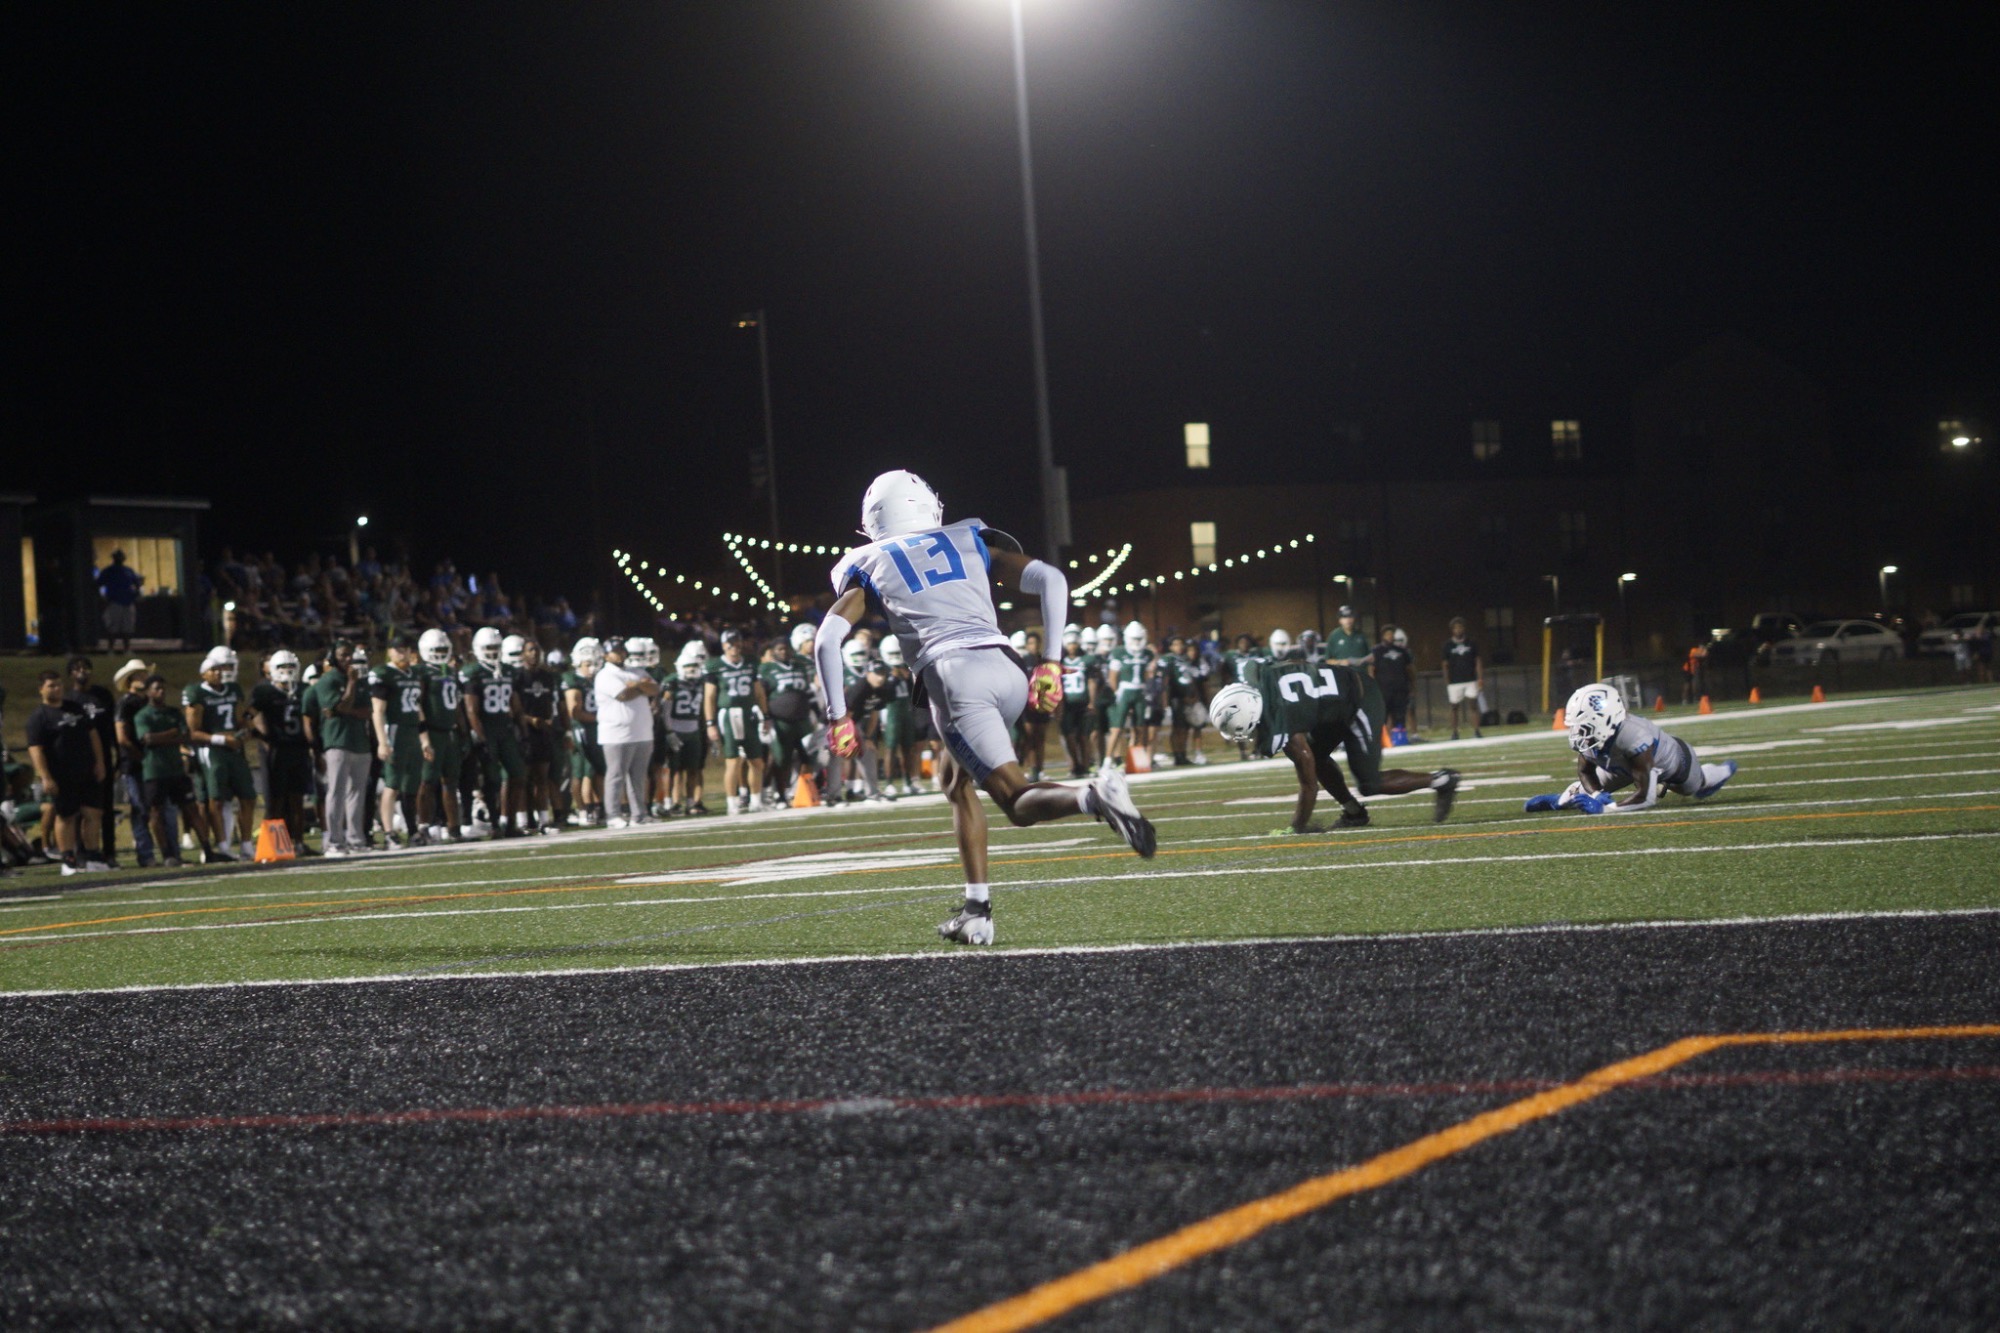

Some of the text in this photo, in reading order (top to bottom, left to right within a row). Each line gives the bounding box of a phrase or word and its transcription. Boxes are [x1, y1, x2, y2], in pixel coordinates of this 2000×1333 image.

[880, 530, 968, 594] 13
[727, 675, 752, 696] 16
[1131, 664, 1141, 684] 1
[1278, 668, 1339, 703] 2
[442, 681, 457, 710] 0
[484, 684, 512, 713] 88
[217, 703, 234, 729] 7
